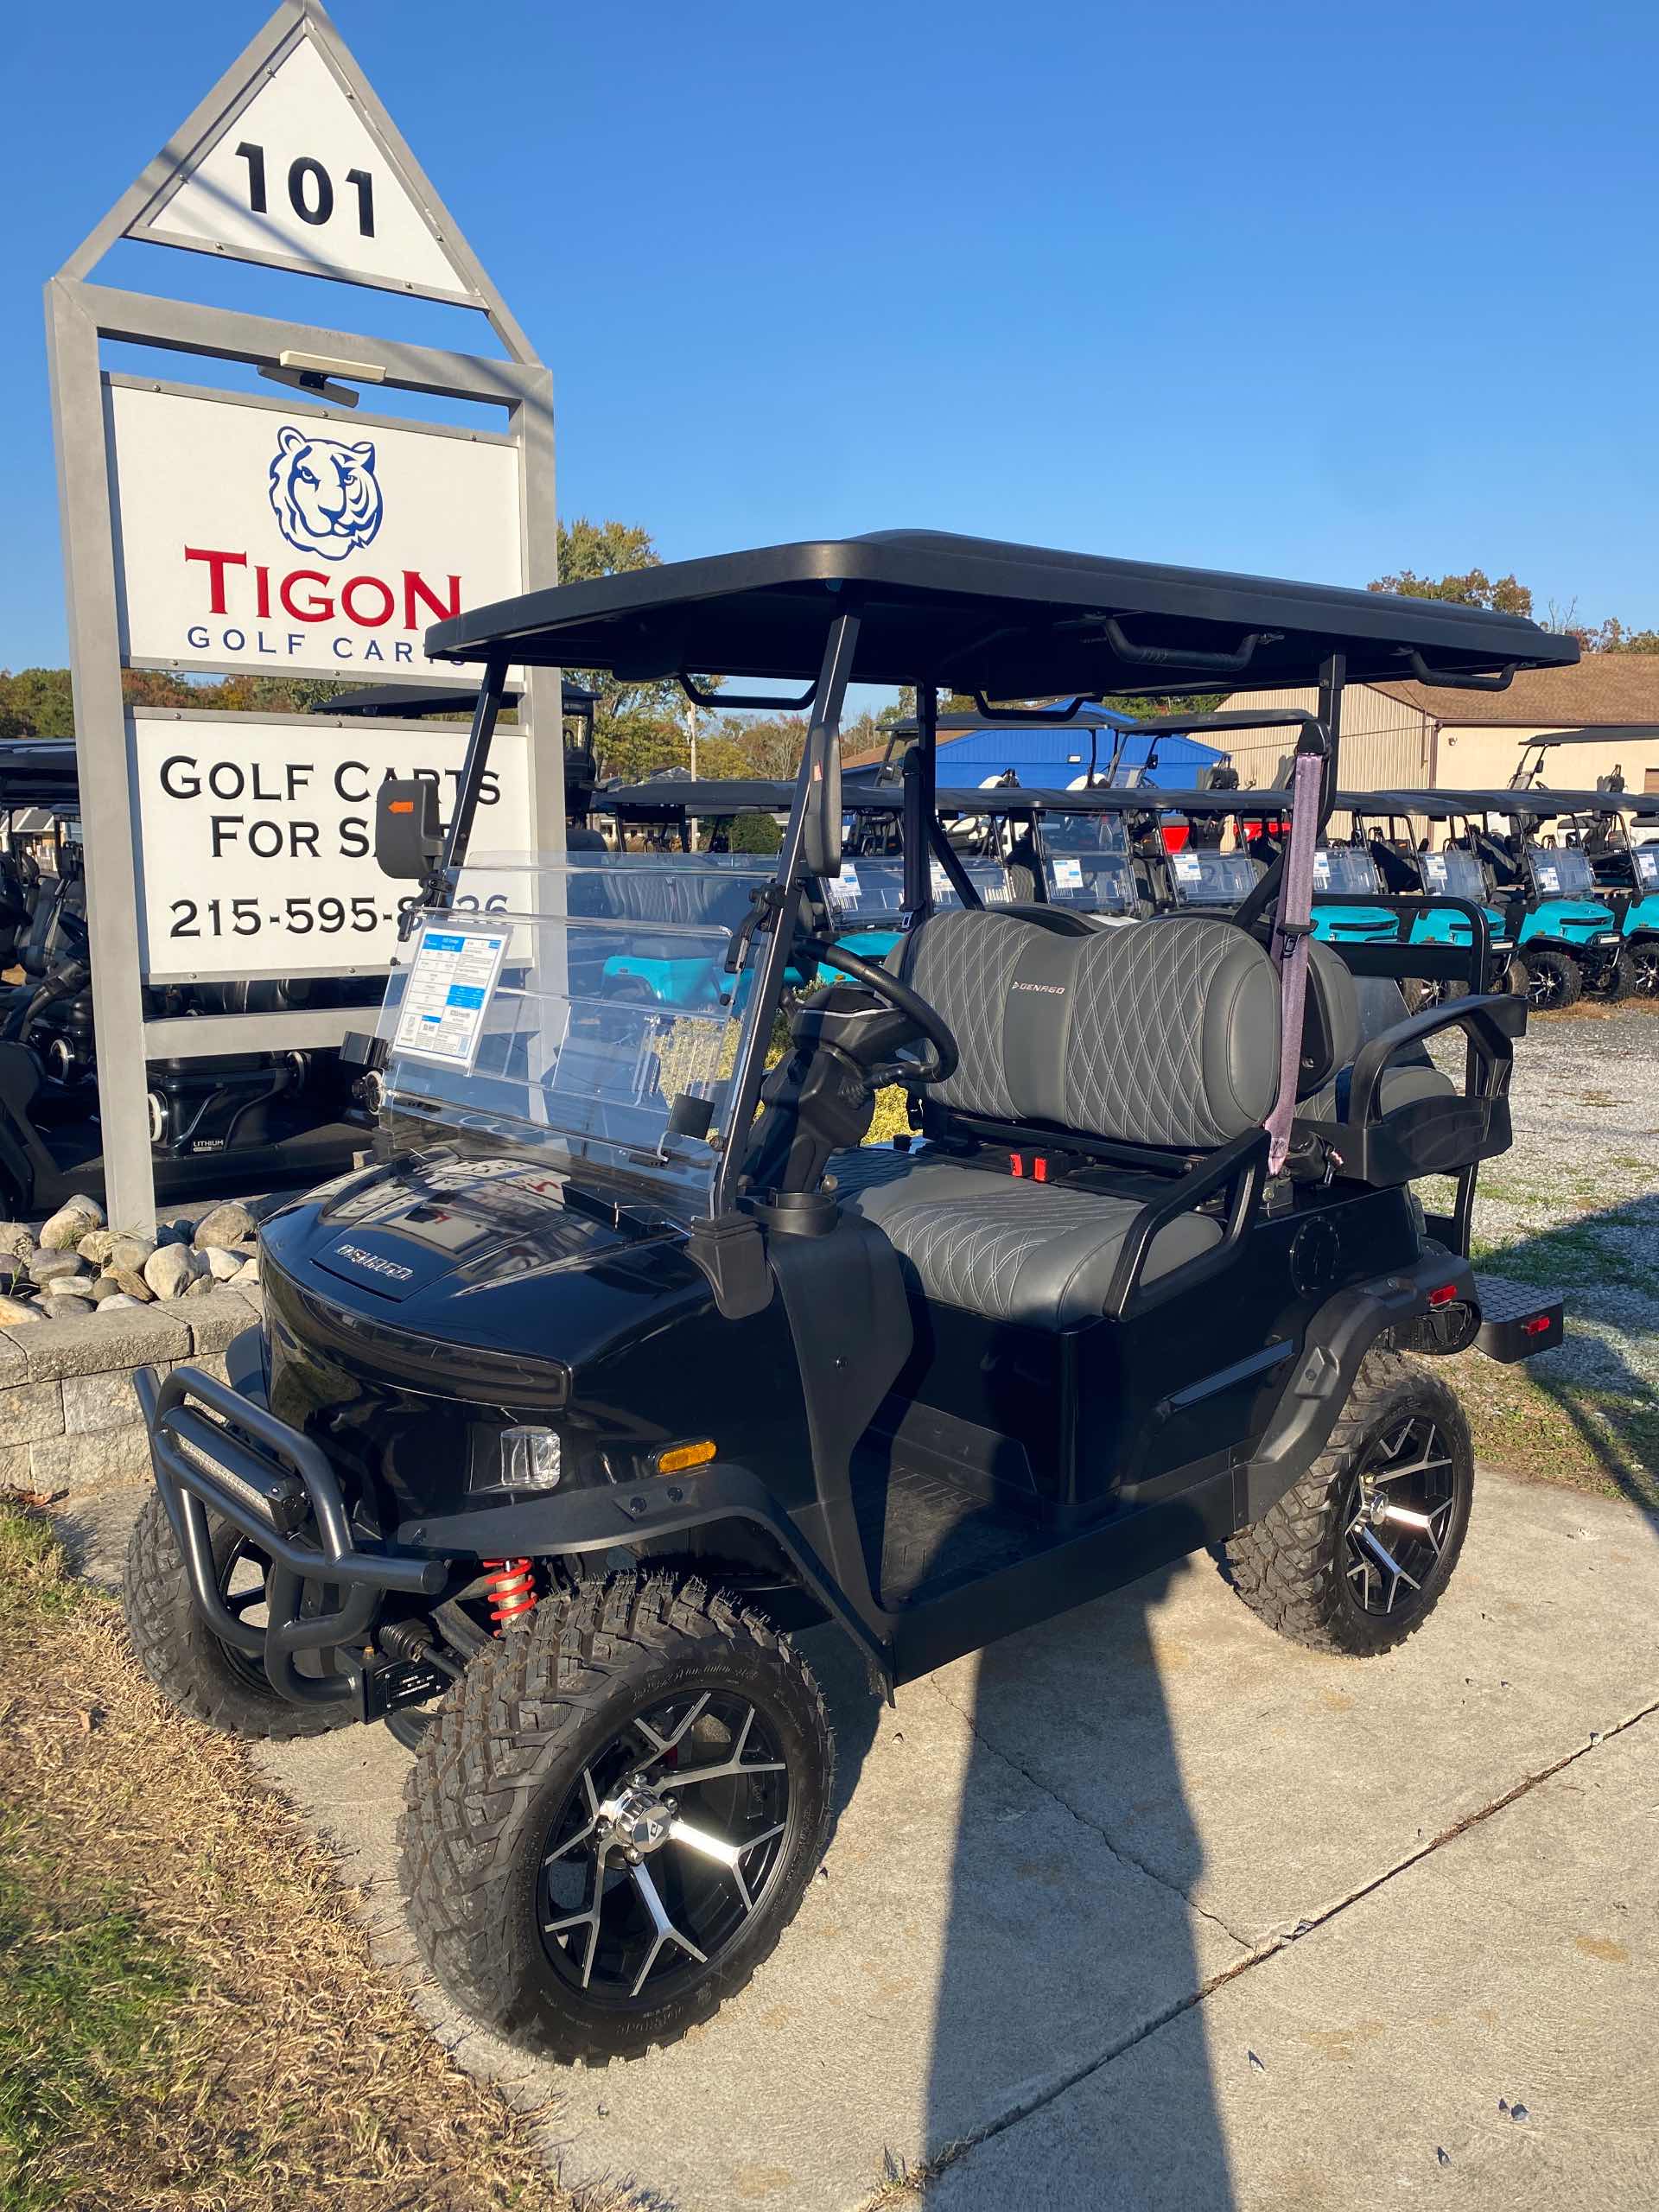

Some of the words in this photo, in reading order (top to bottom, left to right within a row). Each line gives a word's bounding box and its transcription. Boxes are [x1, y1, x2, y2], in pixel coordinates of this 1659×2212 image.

[235, 142, 374, 238] 101
[184, 544, 462, 631] TIGON
[188, 626, 305, 655] GOLF
[333, 637, 465, 666] CAR
[160, 755, 315, 802] GOLF
[334, 760, 500, 805] CTS
[210, 814, 322, 858] FOR
[168, 894, 508, 938] 215-595-86
[1019, 983, 1065, 995] DENAGO
